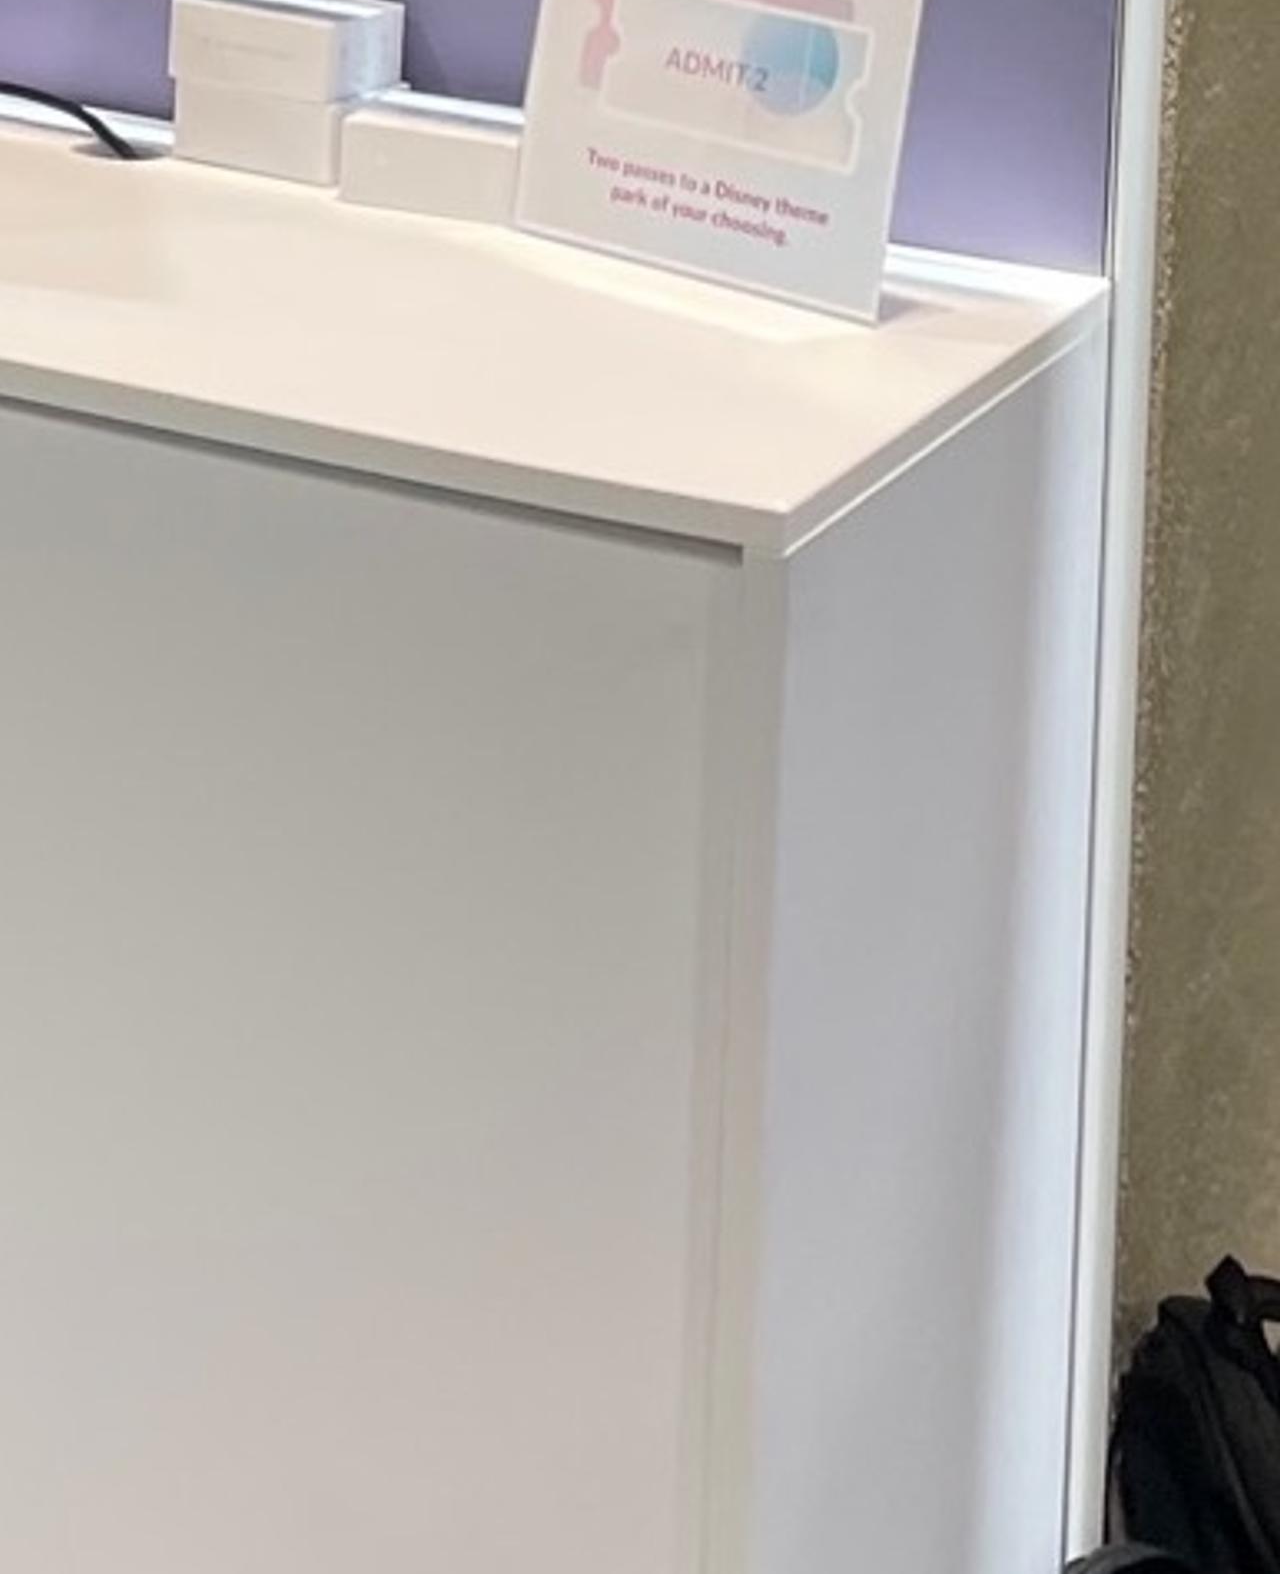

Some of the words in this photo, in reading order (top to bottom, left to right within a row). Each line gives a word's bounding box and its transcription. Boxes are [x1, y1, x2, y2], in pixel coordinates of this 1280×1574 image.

[664, 47, 750, 89] ADMIT
[752, 66, 770, 92] 2
[587, 147, 621, 172] Two
[622, 161, 677, 188] passes
[679, 173, 698, 193] to
[700, 181, 711, 196] a
[714, 180, 771, 212] Disney
[774, 198, 830, 226] theme
[609, 186, 648, 207] park
[650, 195, 670, 212] of
[672, 203, 708, 222] your
